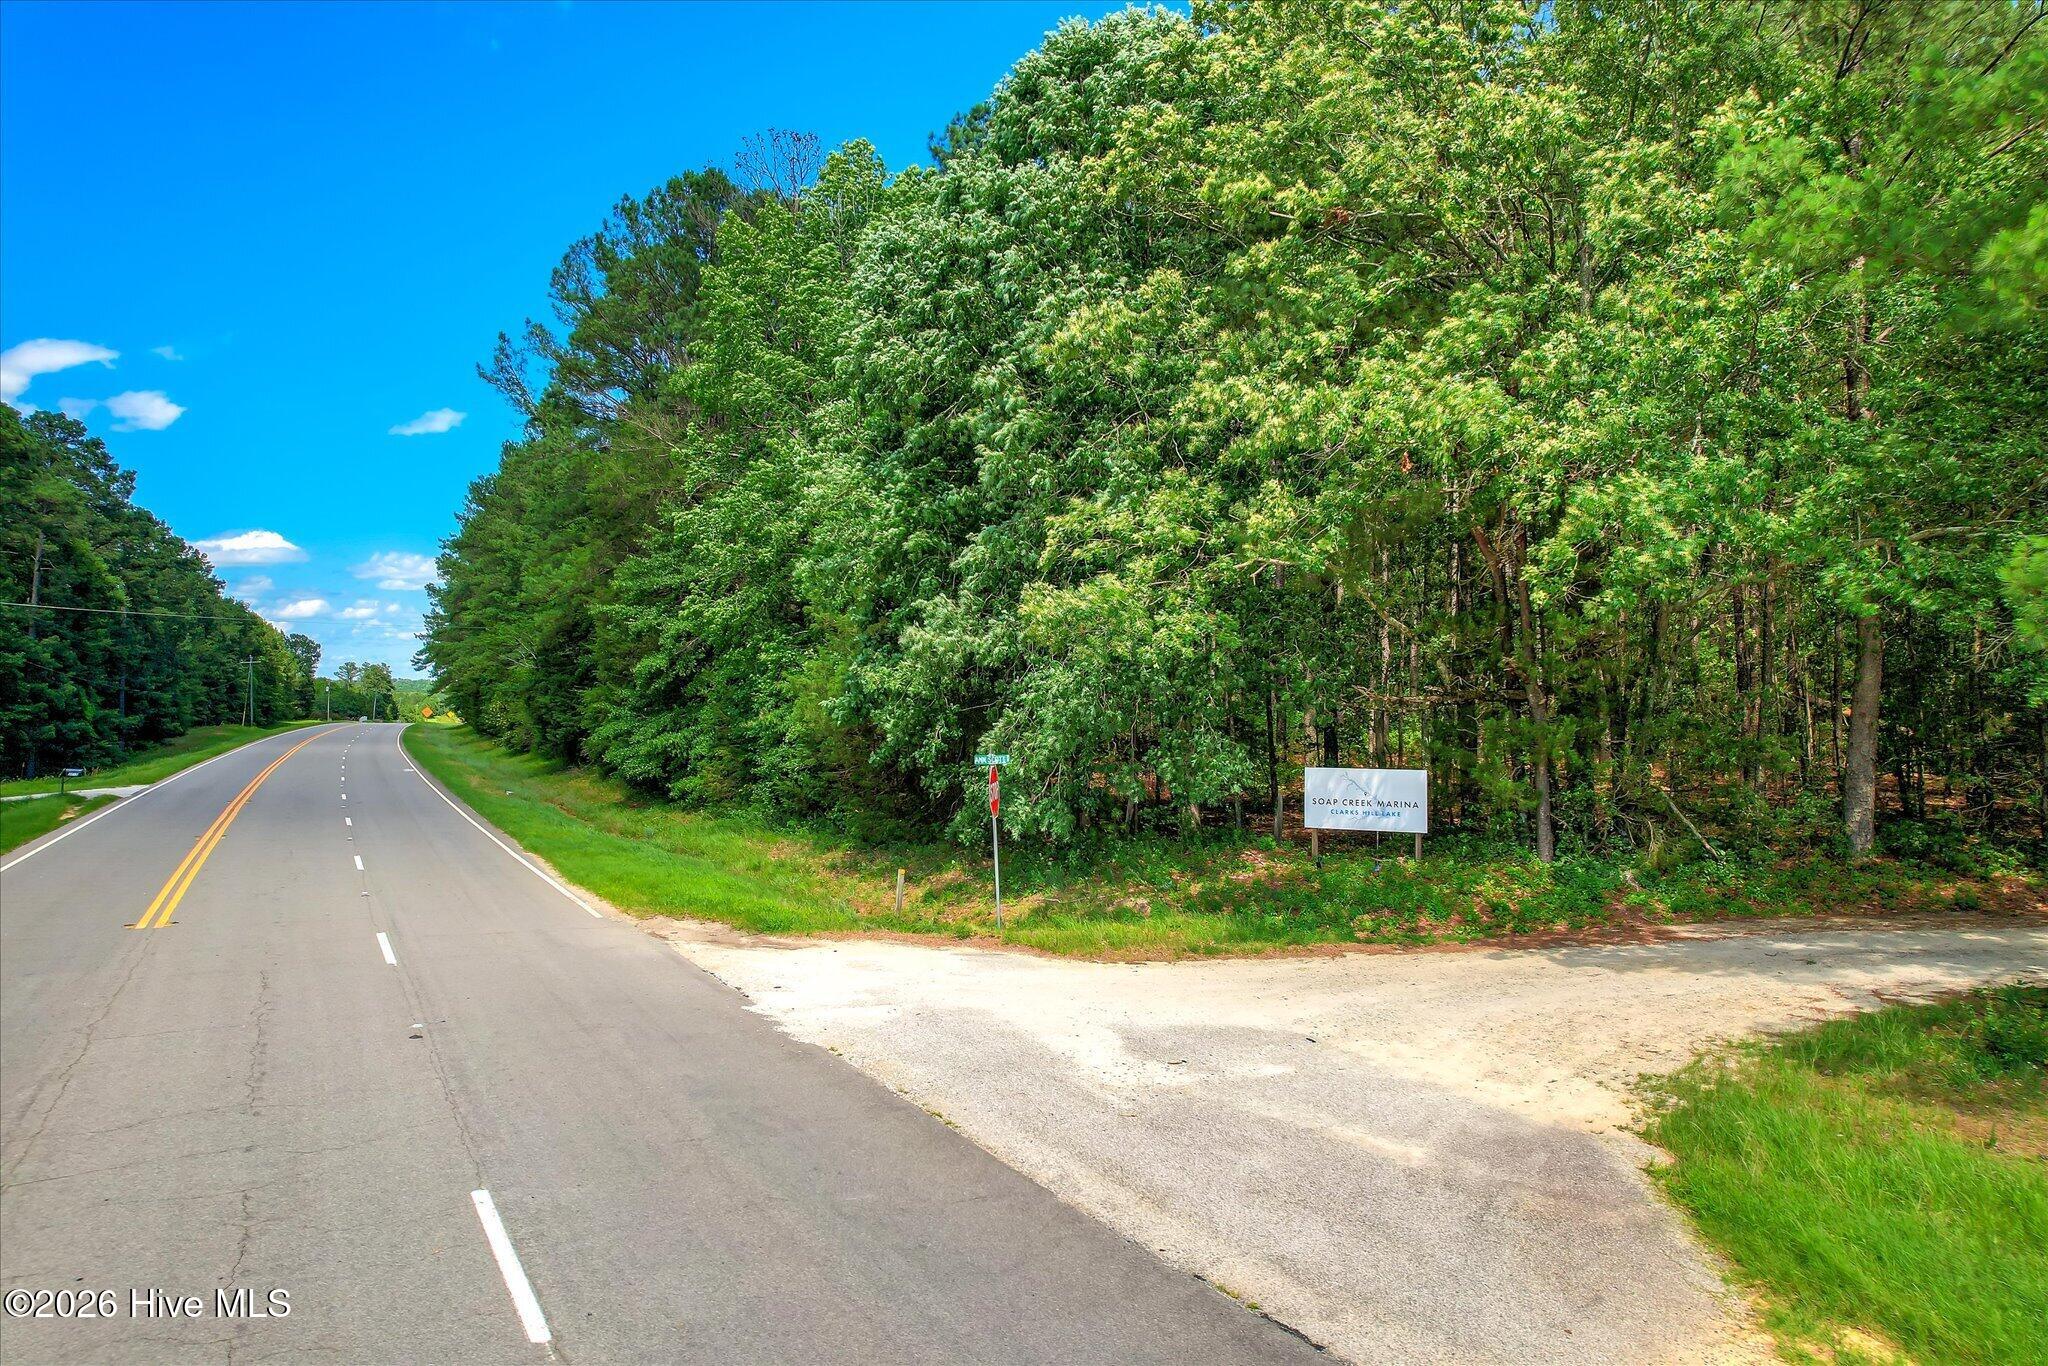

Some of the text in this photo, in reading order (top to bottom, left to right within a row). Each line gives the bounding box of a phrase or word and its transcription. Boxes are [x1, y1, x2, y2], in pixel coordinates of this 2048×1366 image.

[1312, 797, 1419, 809] SOAP CREEK MARINA
[1330, 808, 1359, 816] CLARKS
